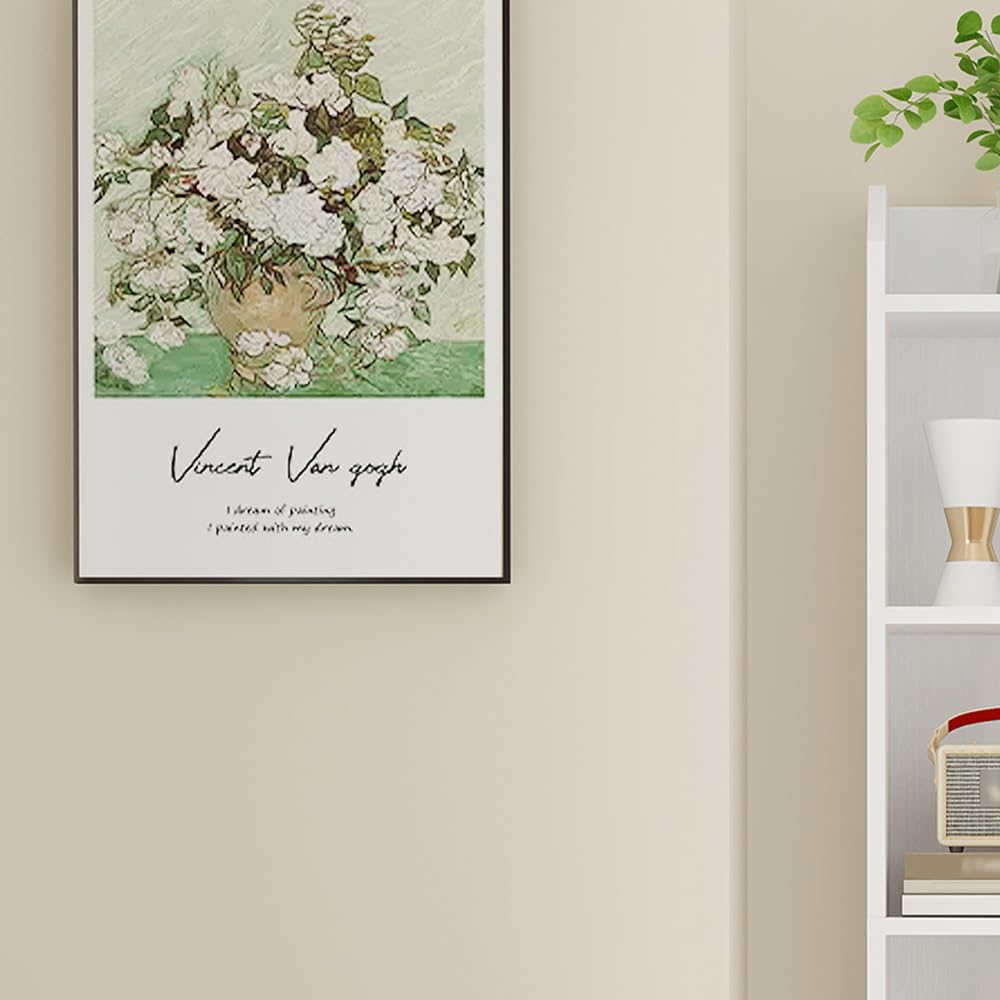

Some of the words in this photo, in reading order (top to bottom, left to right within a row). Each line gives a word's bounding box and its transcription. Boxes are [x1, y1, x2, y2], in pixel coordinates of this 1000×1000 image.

[171, 427, 272, 483] Vincent
[287, 427, 340, 483] Van
[233, 504, 271, 515] dream
[274, 503, 287, 516] of
[288, 504, 336, 519] painting
[215, 521, 258, 536] painted
[262, 521, 289, 533] with
[292, 524, 311, 537] my
[314, 521, 353, 533] dream
